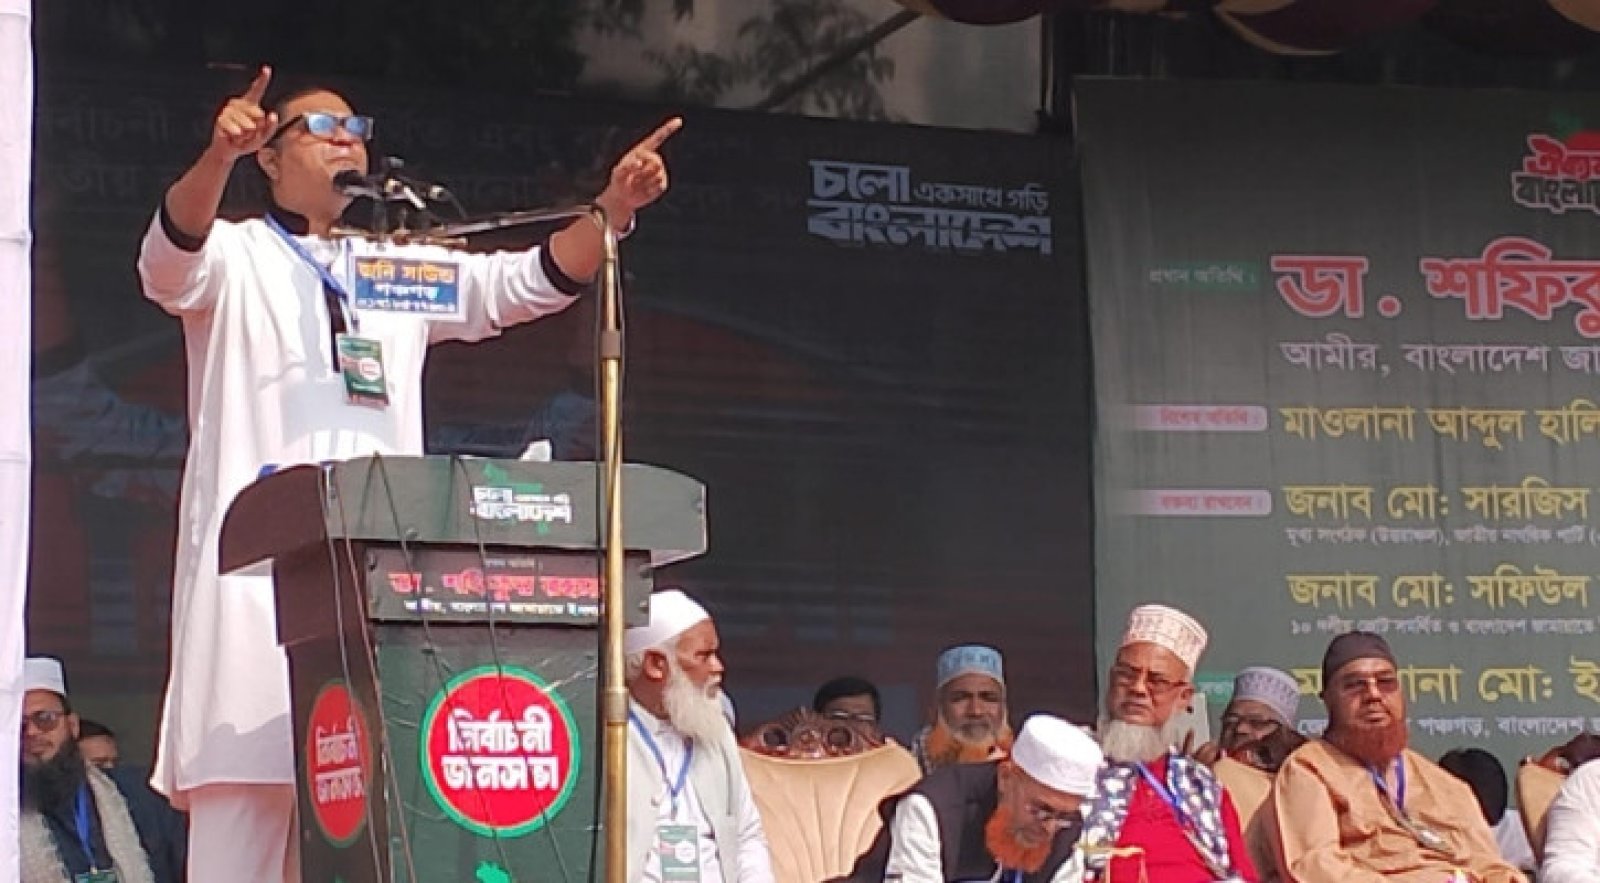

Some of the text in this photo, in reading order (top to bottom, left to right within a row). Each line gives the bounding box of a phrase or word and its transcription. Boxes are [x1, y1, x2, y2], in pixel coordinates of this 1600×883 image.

[807, 158, 910, 202] চলো
[913, 182, 1002, 209] একসাথে
[1006, 182, 1049, 218] গড়ি
[807, 199, 1053, 255] বাংলাদেশ
[1280, 333, 1392, 378] আমীর,
[1400, 342, 1552, 375] বাংলাদেশ
[1280, 404, 1415, 442] মাওলানা
[1427, 404, 1527, 450] আব্দুল
[1283, 484, 1374, 521] জনাব
[1463, 477, 1590, 521] সারজিস
[1285, 570, 1380, 609] জনাব
[1466, 562, 1592, 609] সফিউল
[447, 704, 553, 753] নির্বাচনী
[1495, 713, 1584, 736] বাংলাদেশ
